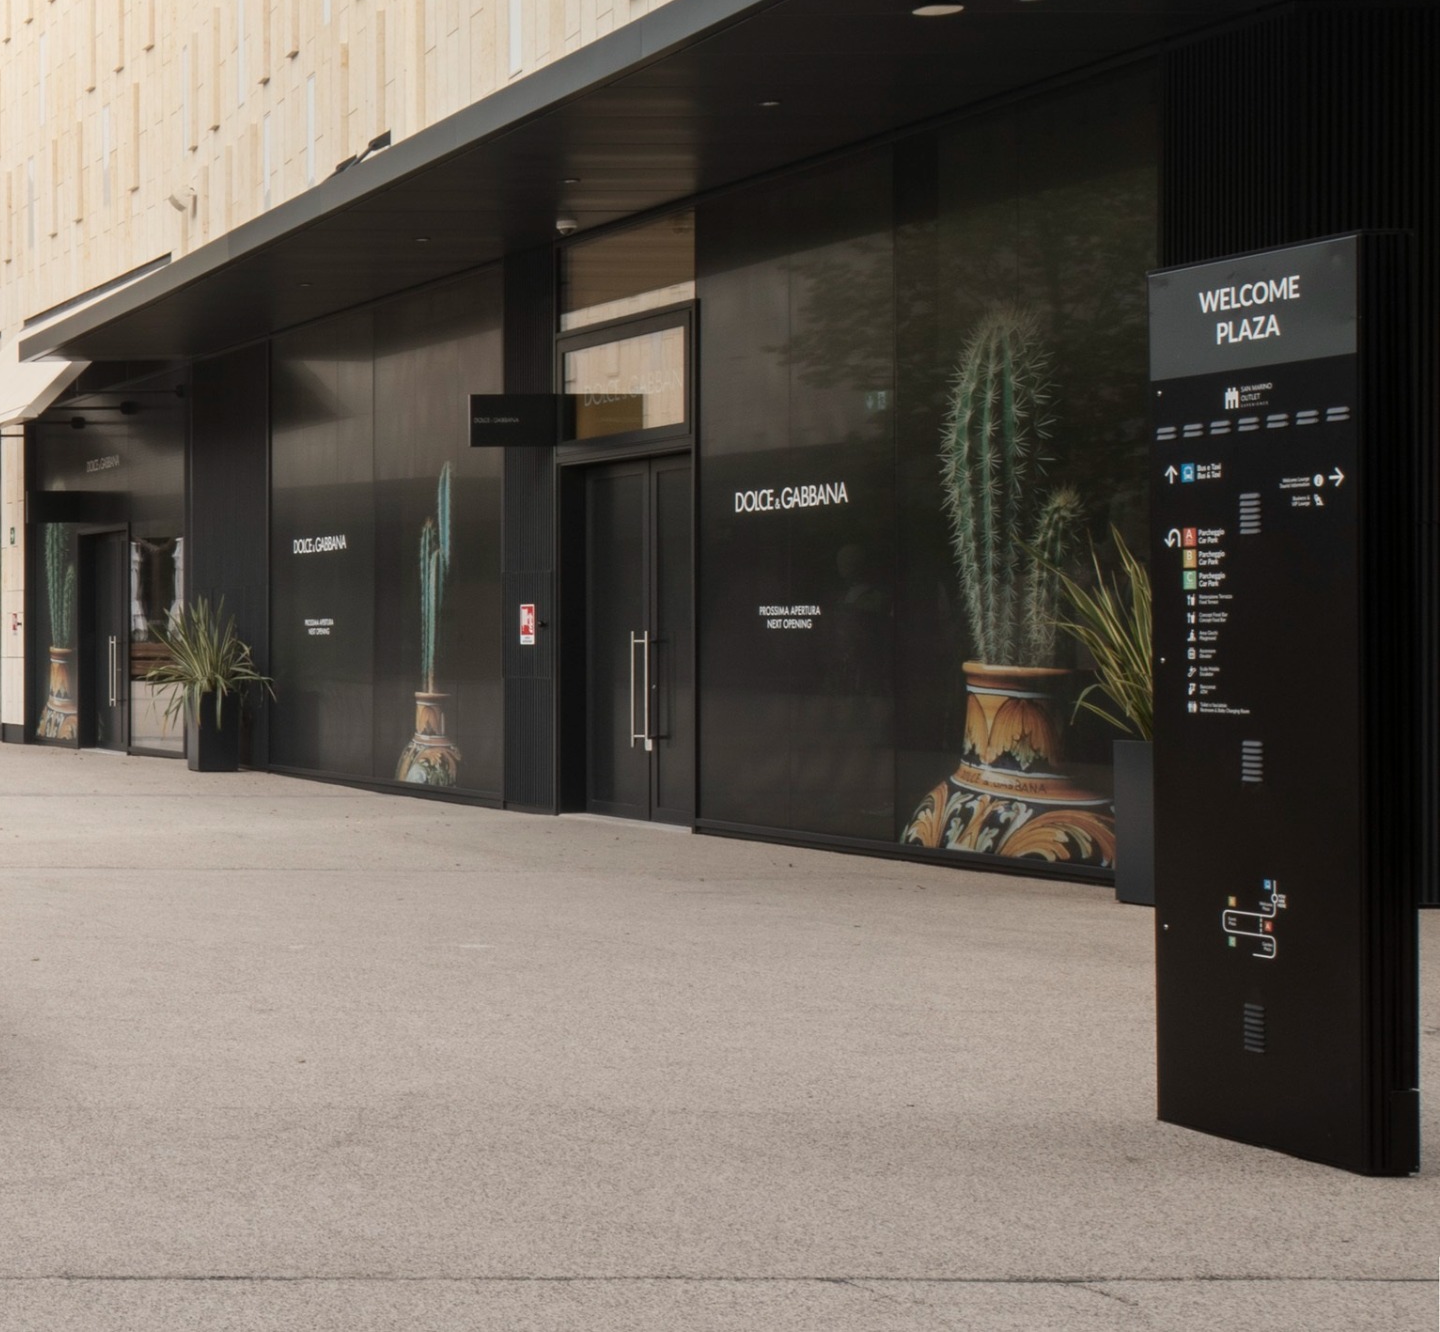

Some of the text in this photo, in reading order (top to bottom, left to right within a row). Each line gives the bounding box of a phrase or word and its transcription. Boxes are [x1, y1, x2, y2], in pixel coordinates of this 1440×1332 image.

[1198, 275, 1300, 314] WELCOME
[1216, 314, 1280, 346] PLAZA
[1240, 382, 1273, 393] SAN MARINO
[1240, 392, 1261, 402] OUTLET
[1186, 528, 1193, 539] A
[1186, 550, 1192, 560] B
[1186, 572, 1193, 582] C
[759, 605, 821, 616] PROSSIMA APERTURA
[767, 619, 812, 629] NEXT OPENING
